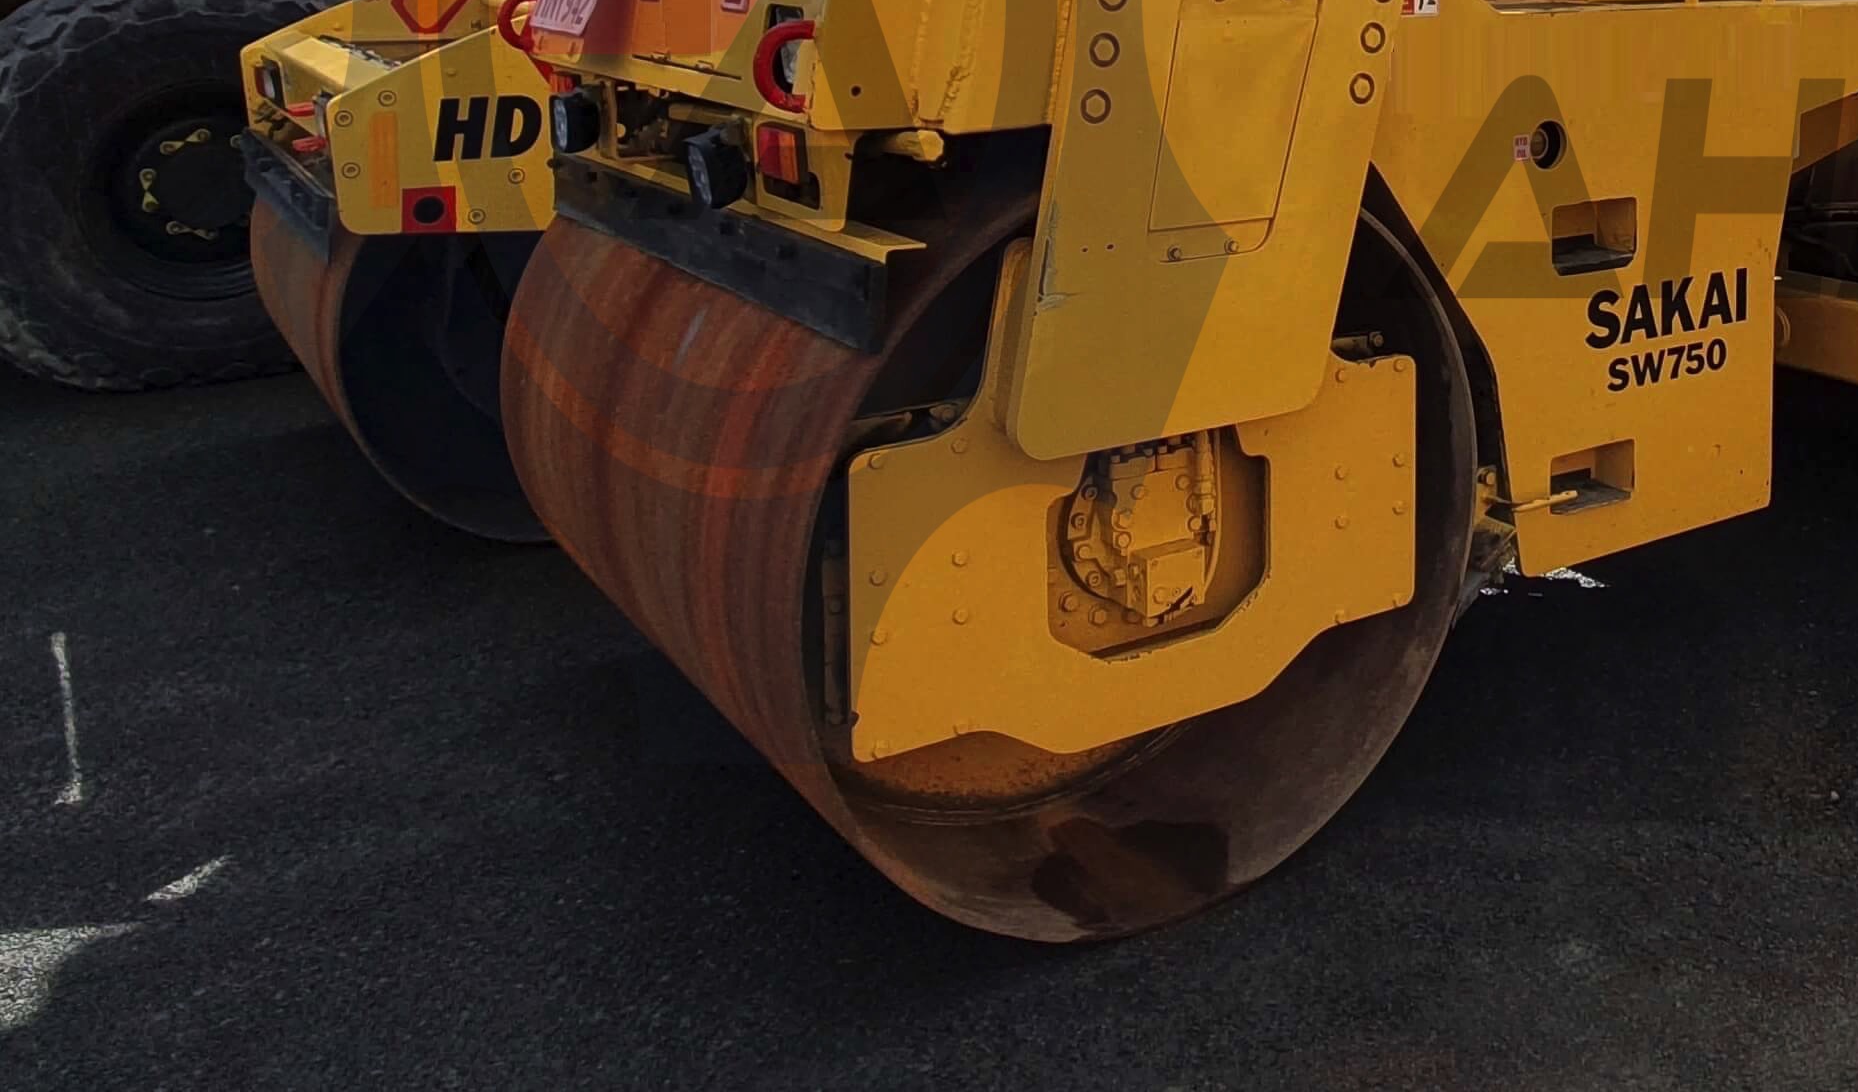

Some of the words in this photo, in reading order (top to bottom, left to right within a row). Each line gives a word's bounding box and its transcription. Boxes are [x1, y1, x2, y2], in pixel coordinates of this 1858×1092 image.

[433, 94, 542, 162] HD
[1585, 267, 1748, 349] SAKAI
[1607, 338, 1727, 392] SW750
